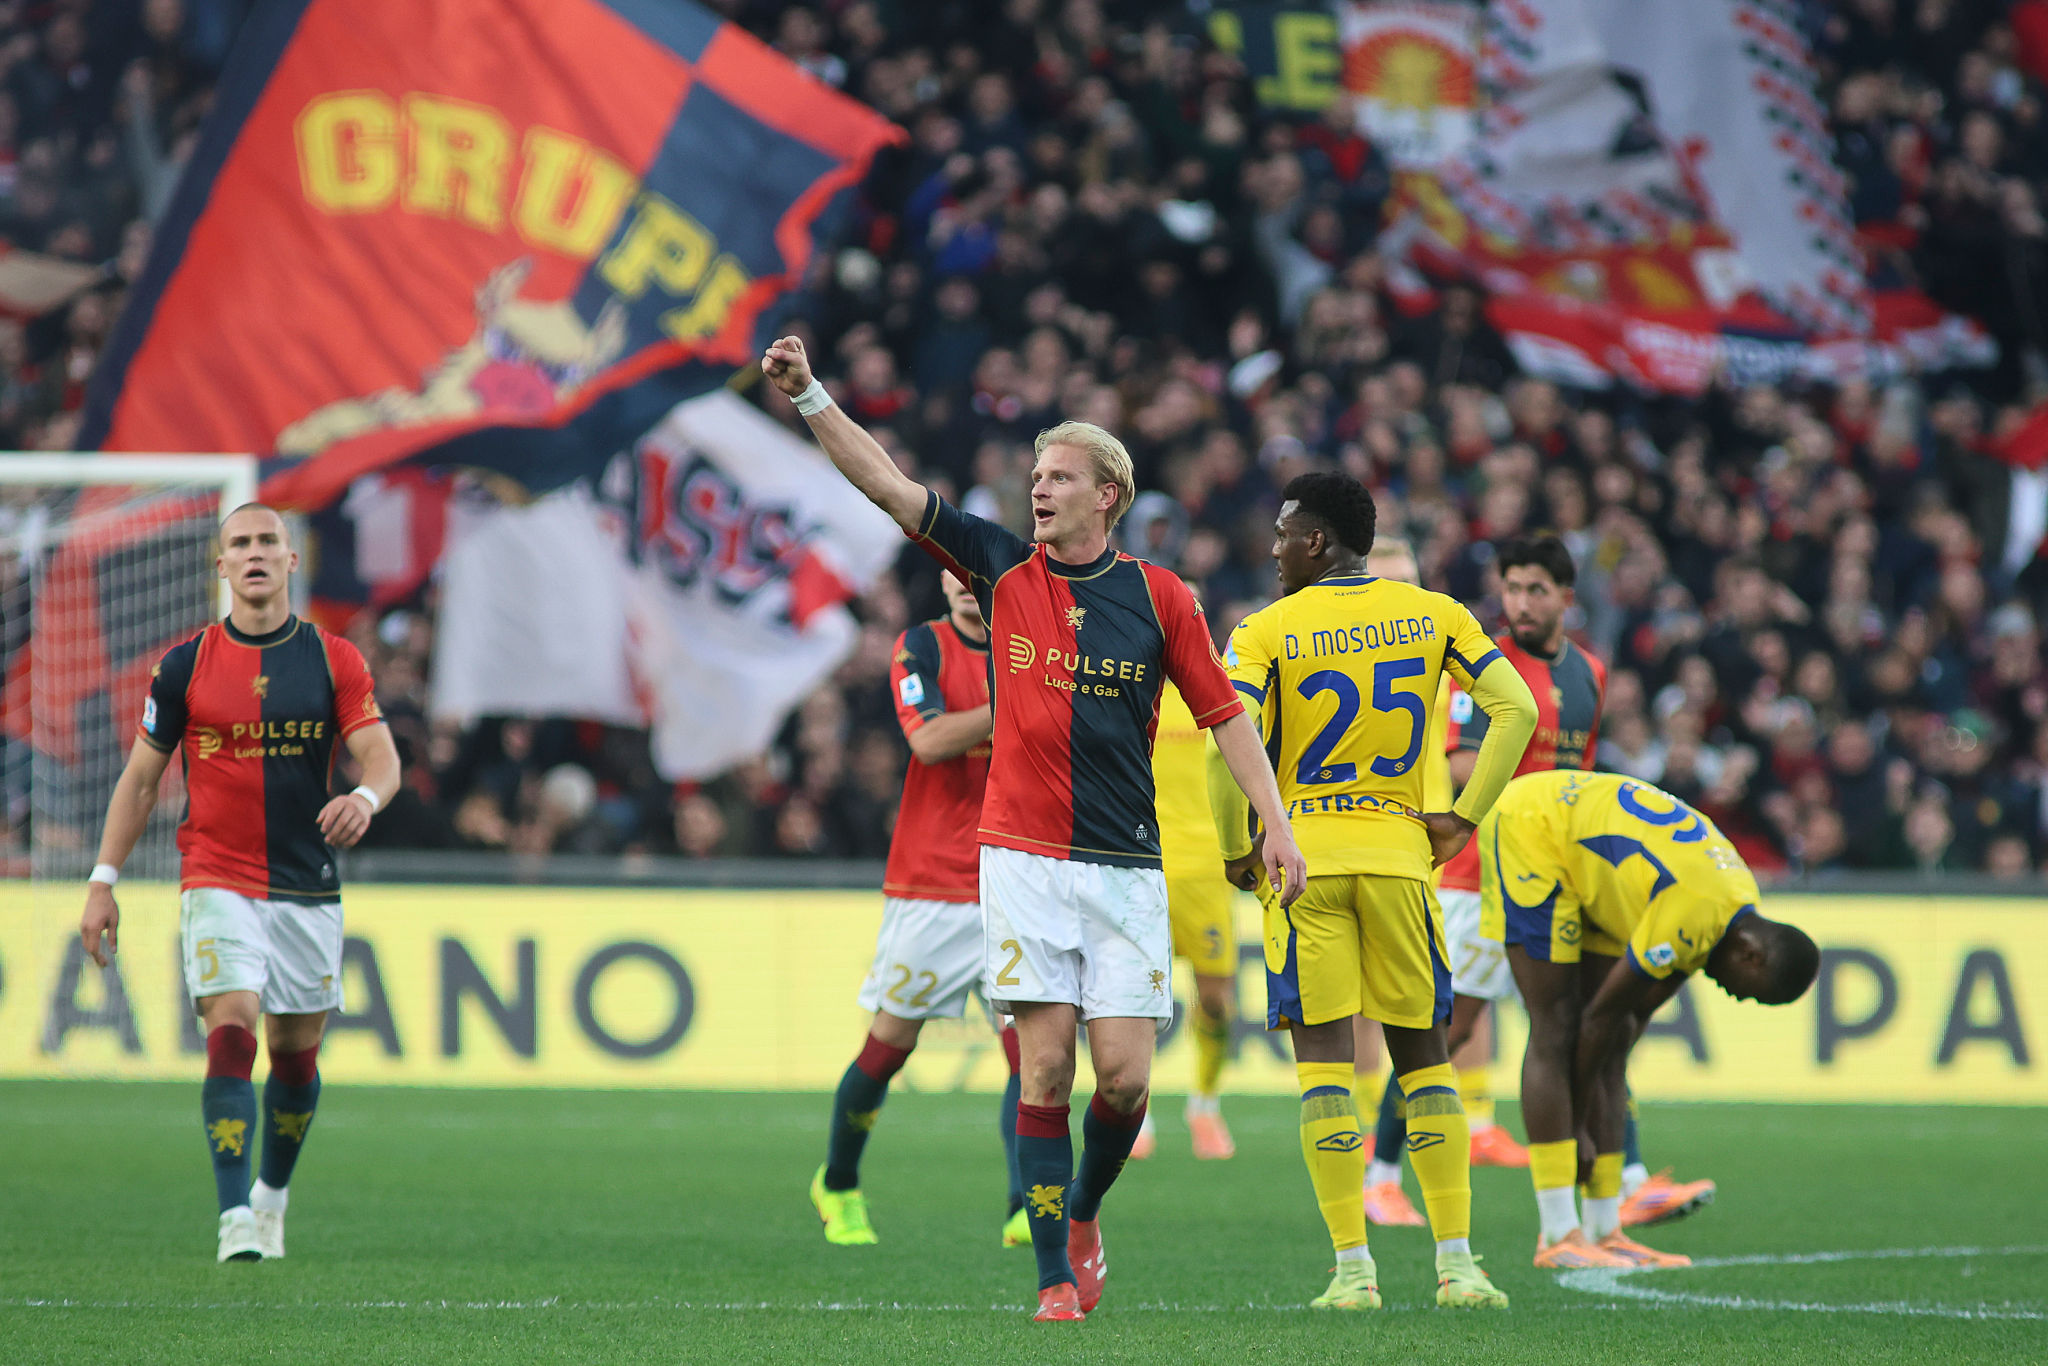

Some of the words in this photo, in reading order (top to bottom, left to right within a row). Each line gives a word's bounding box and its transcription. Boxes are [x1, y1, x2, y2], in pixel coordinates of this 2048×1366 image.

[1285, 634, 1306, 660] D.
[1312, 616, 1436, 657] MOSQUERA
[1044, 673, 1078, 692] Luce
[1081, 684, 1090, 694] e
[1093, 684, 1120, 697] Gas
[1045, 647, 1146, 683] PULSEE
[232, 720, 325, 740] PULSEE
[1297, 656, 1426, 785] 25
[234, 747, 266, 759] Luce
[196, 938, 219, 983] 5
[996, 938, 1023, 986] 2
[1455, 943, 1504, 985] 77
[0, 934, 697, 1059] AANO
[886, 963, 938, 1007] 22
